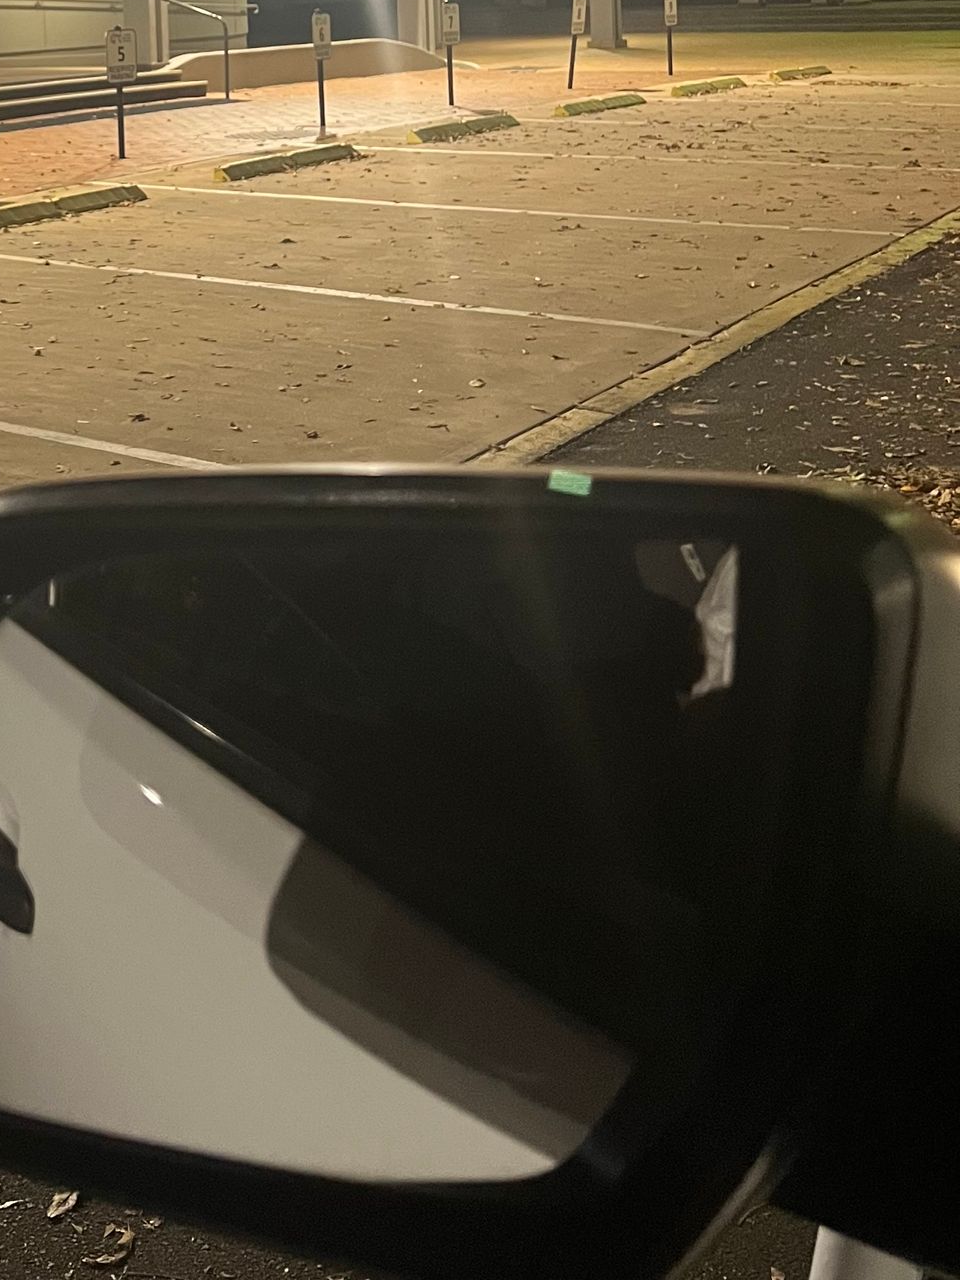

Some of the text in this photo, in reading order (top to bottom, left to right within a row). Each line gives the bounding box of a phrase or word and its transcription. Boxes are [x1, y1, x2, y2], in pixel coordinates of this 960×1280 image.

[448, 14, 455, 29] 7
[319, 26, 325, 42] 6
[117, 45, 126, 62] 5
